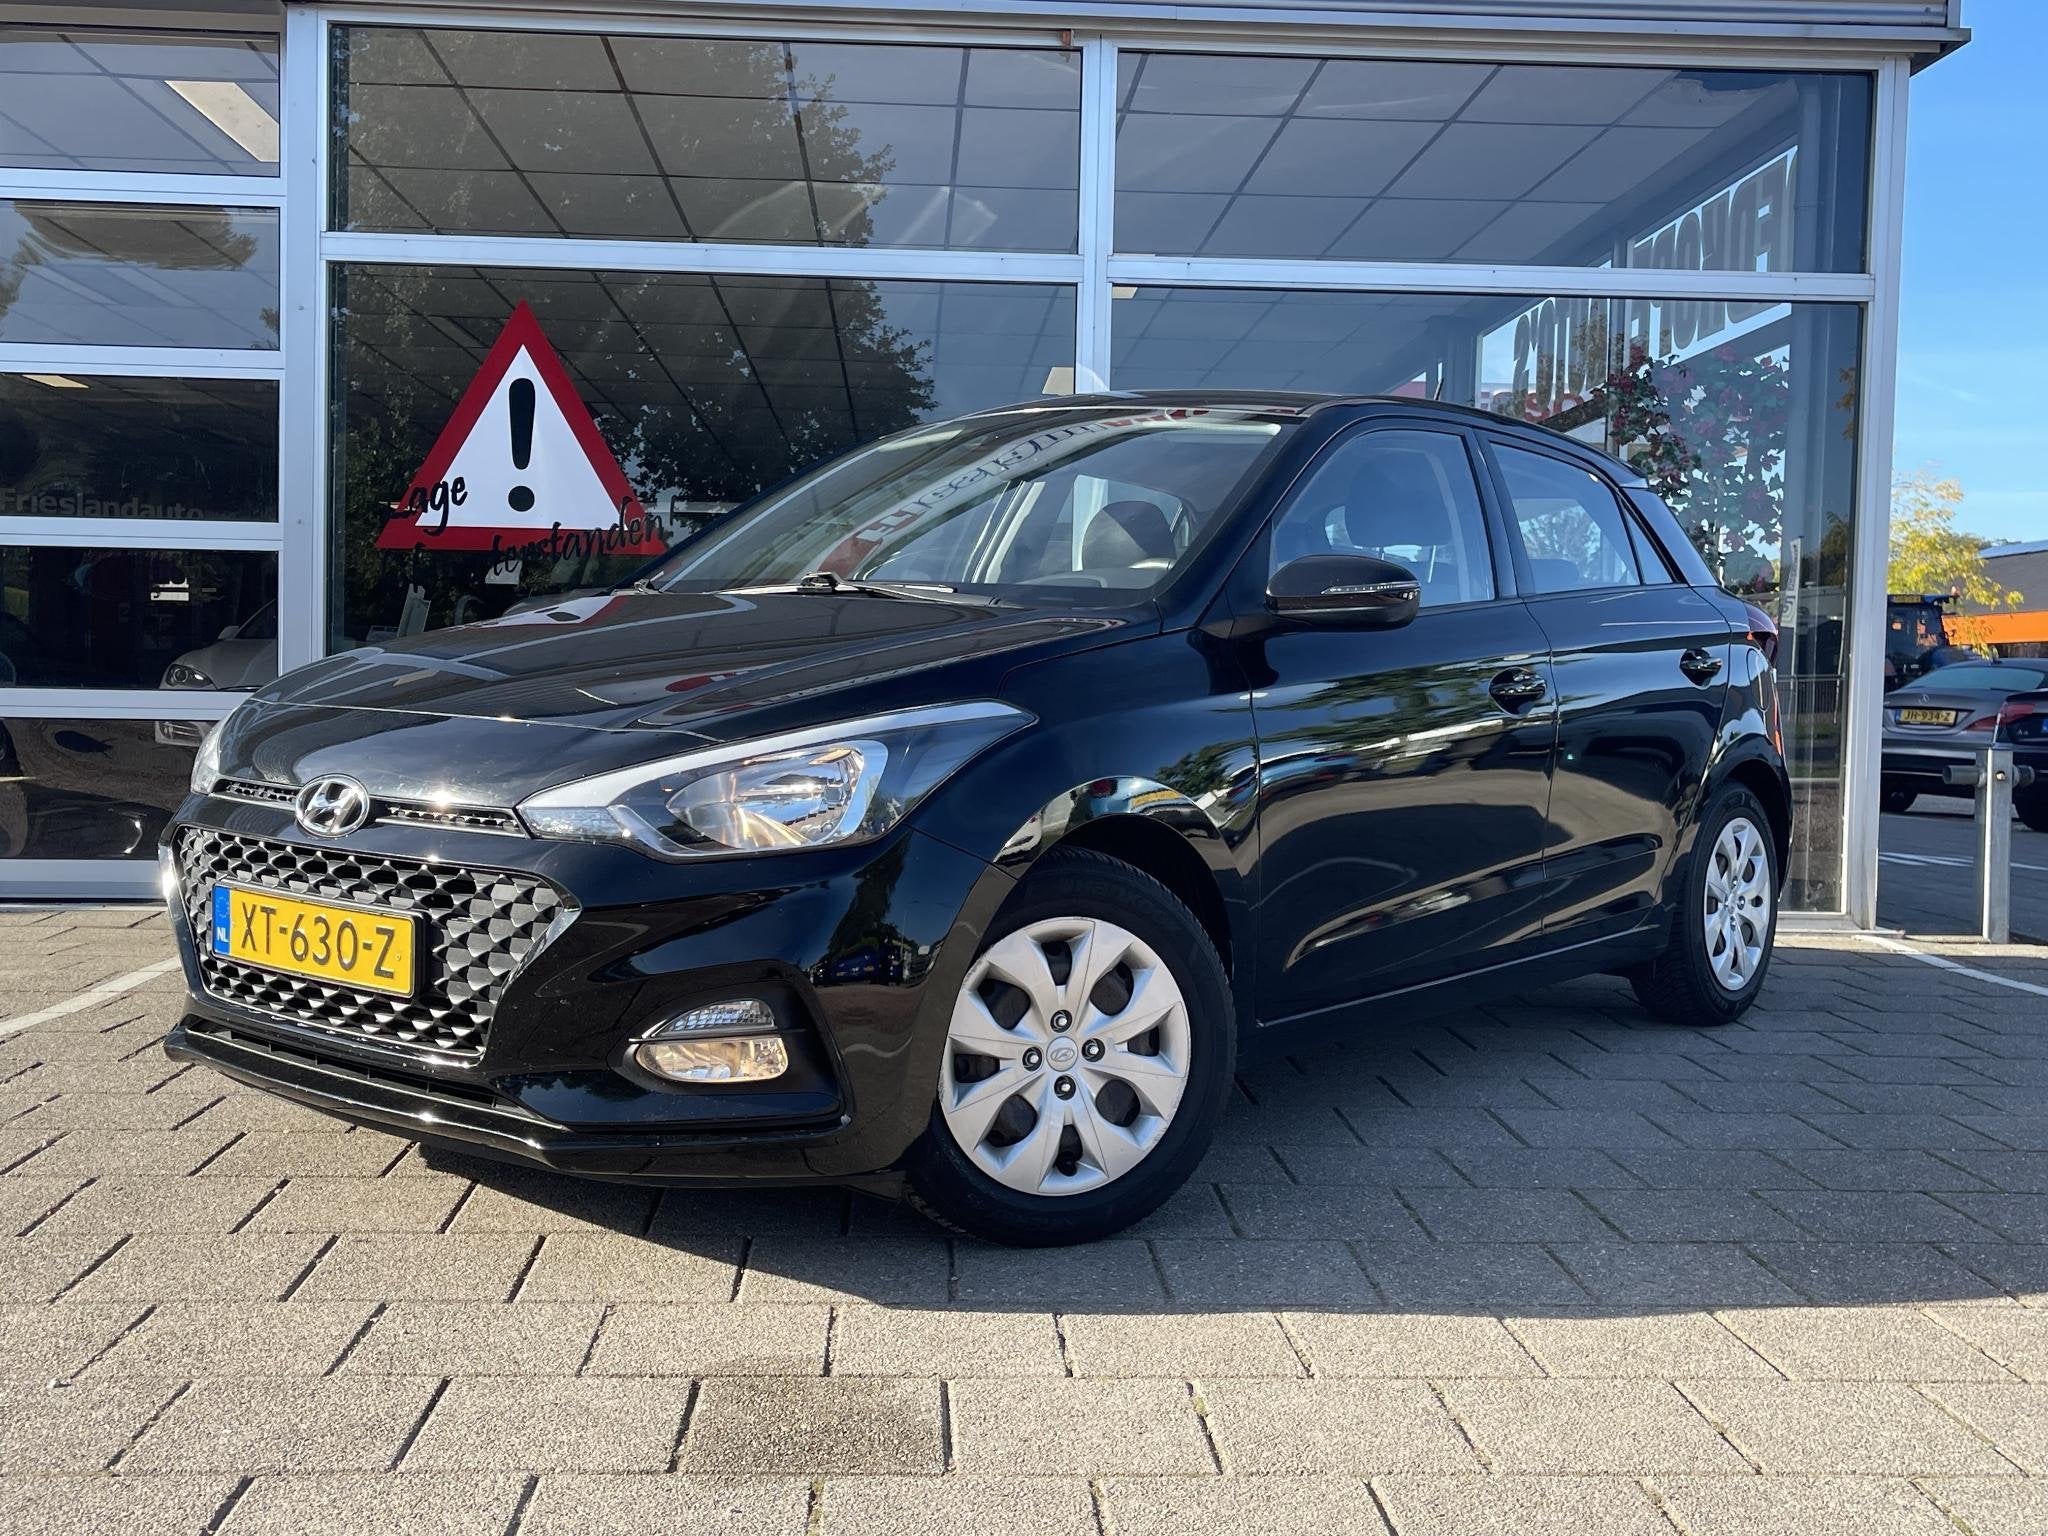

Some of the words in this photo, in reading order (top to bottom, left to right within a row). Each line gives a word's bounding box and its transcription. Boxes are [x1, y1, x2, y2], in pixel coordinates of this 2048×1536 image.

[1904, 710, 1951, 722] JH-934-Z
[217, 927, 229, 943] NL
[241, 902, 395, 979] XT-630-Z
